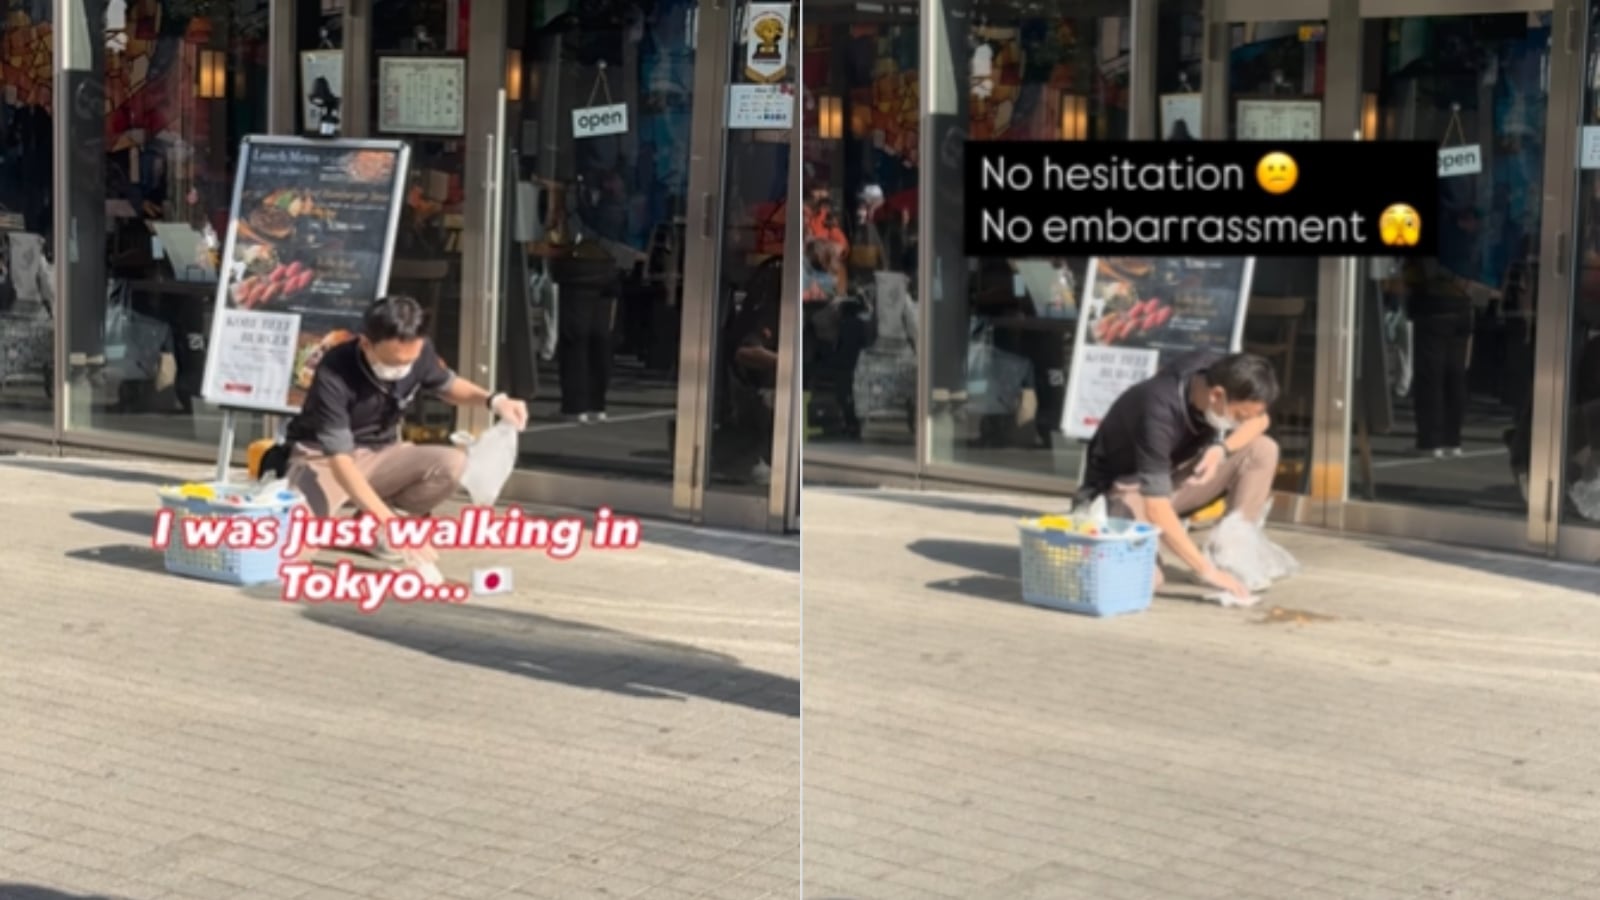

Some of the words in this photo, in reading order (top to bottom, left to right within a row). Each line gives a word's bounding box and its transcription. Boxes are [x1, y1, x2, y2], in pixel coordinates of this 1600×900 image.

[577, 111, 622, 131] open
[252, 148, 287, 162] Lunch
[289, 150, 320, 163] Menu
